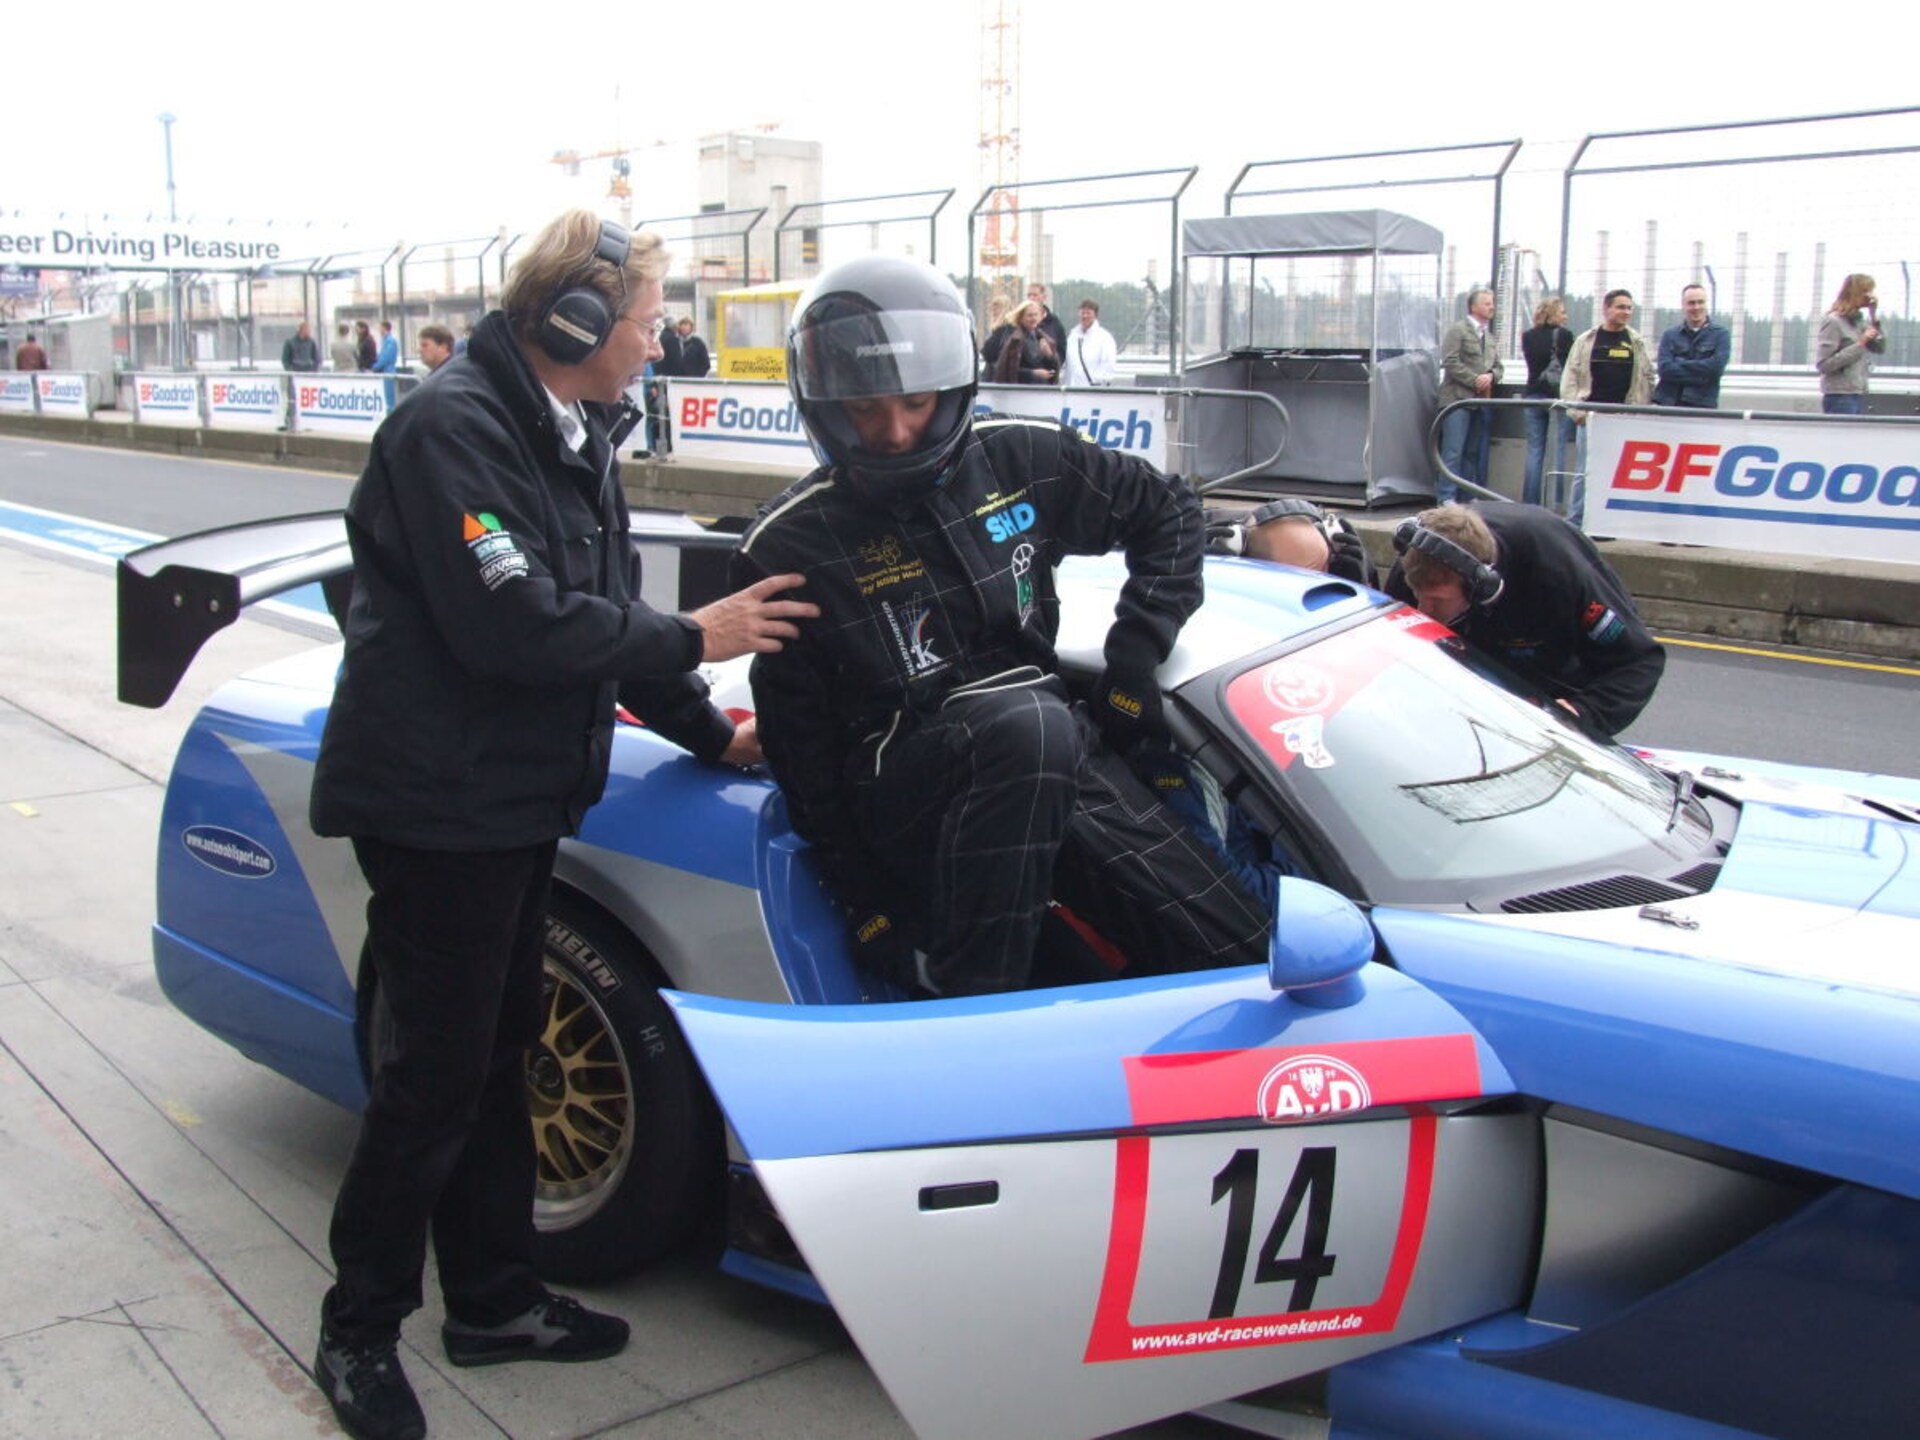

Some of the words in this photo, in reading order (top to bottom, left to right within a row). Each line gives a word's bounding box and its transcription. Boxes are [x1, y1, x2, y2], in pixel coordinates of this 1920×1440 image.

[52, 230, 155, 262] Driving
[163, 233, 280, 259] Pleasure
[140, 383, 195, 402] BFGoodrich
[213, 384, 280, 405] BFGoodrich
[300, 387, 383, 412] BFGoodrich
[1208, 1146, 1337, 1320] 14
[1131, 1314, 1363, 1351] www.avd-raceweekend.de
